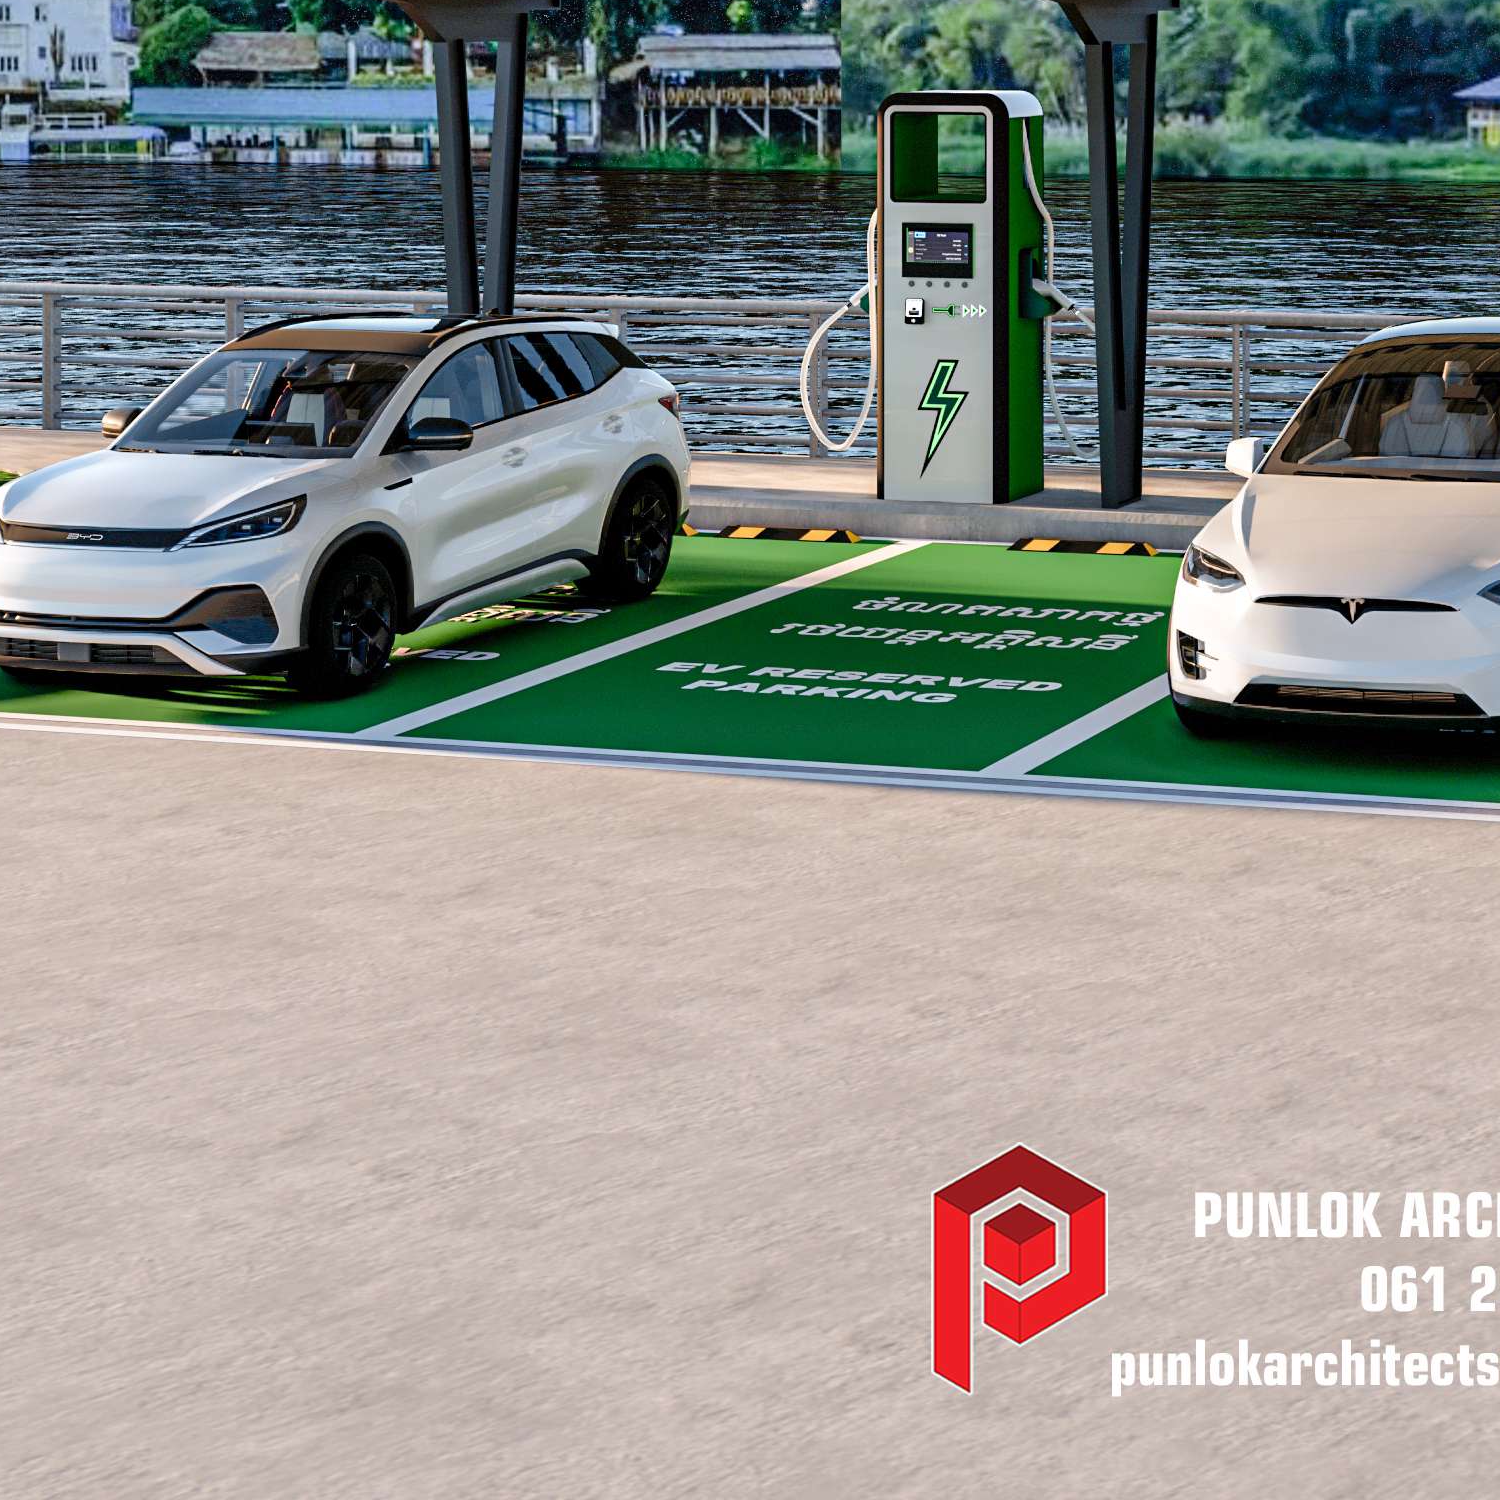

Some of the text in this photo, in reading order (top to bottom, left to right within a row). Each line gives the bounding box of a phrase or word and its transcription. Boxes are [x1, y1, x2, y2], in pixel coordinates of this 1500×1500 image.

[66, 532, 104, 541] BYD
[655, 661, 1064, 692] EV RESERVED
[681, 679, 959, 703] PARKING
